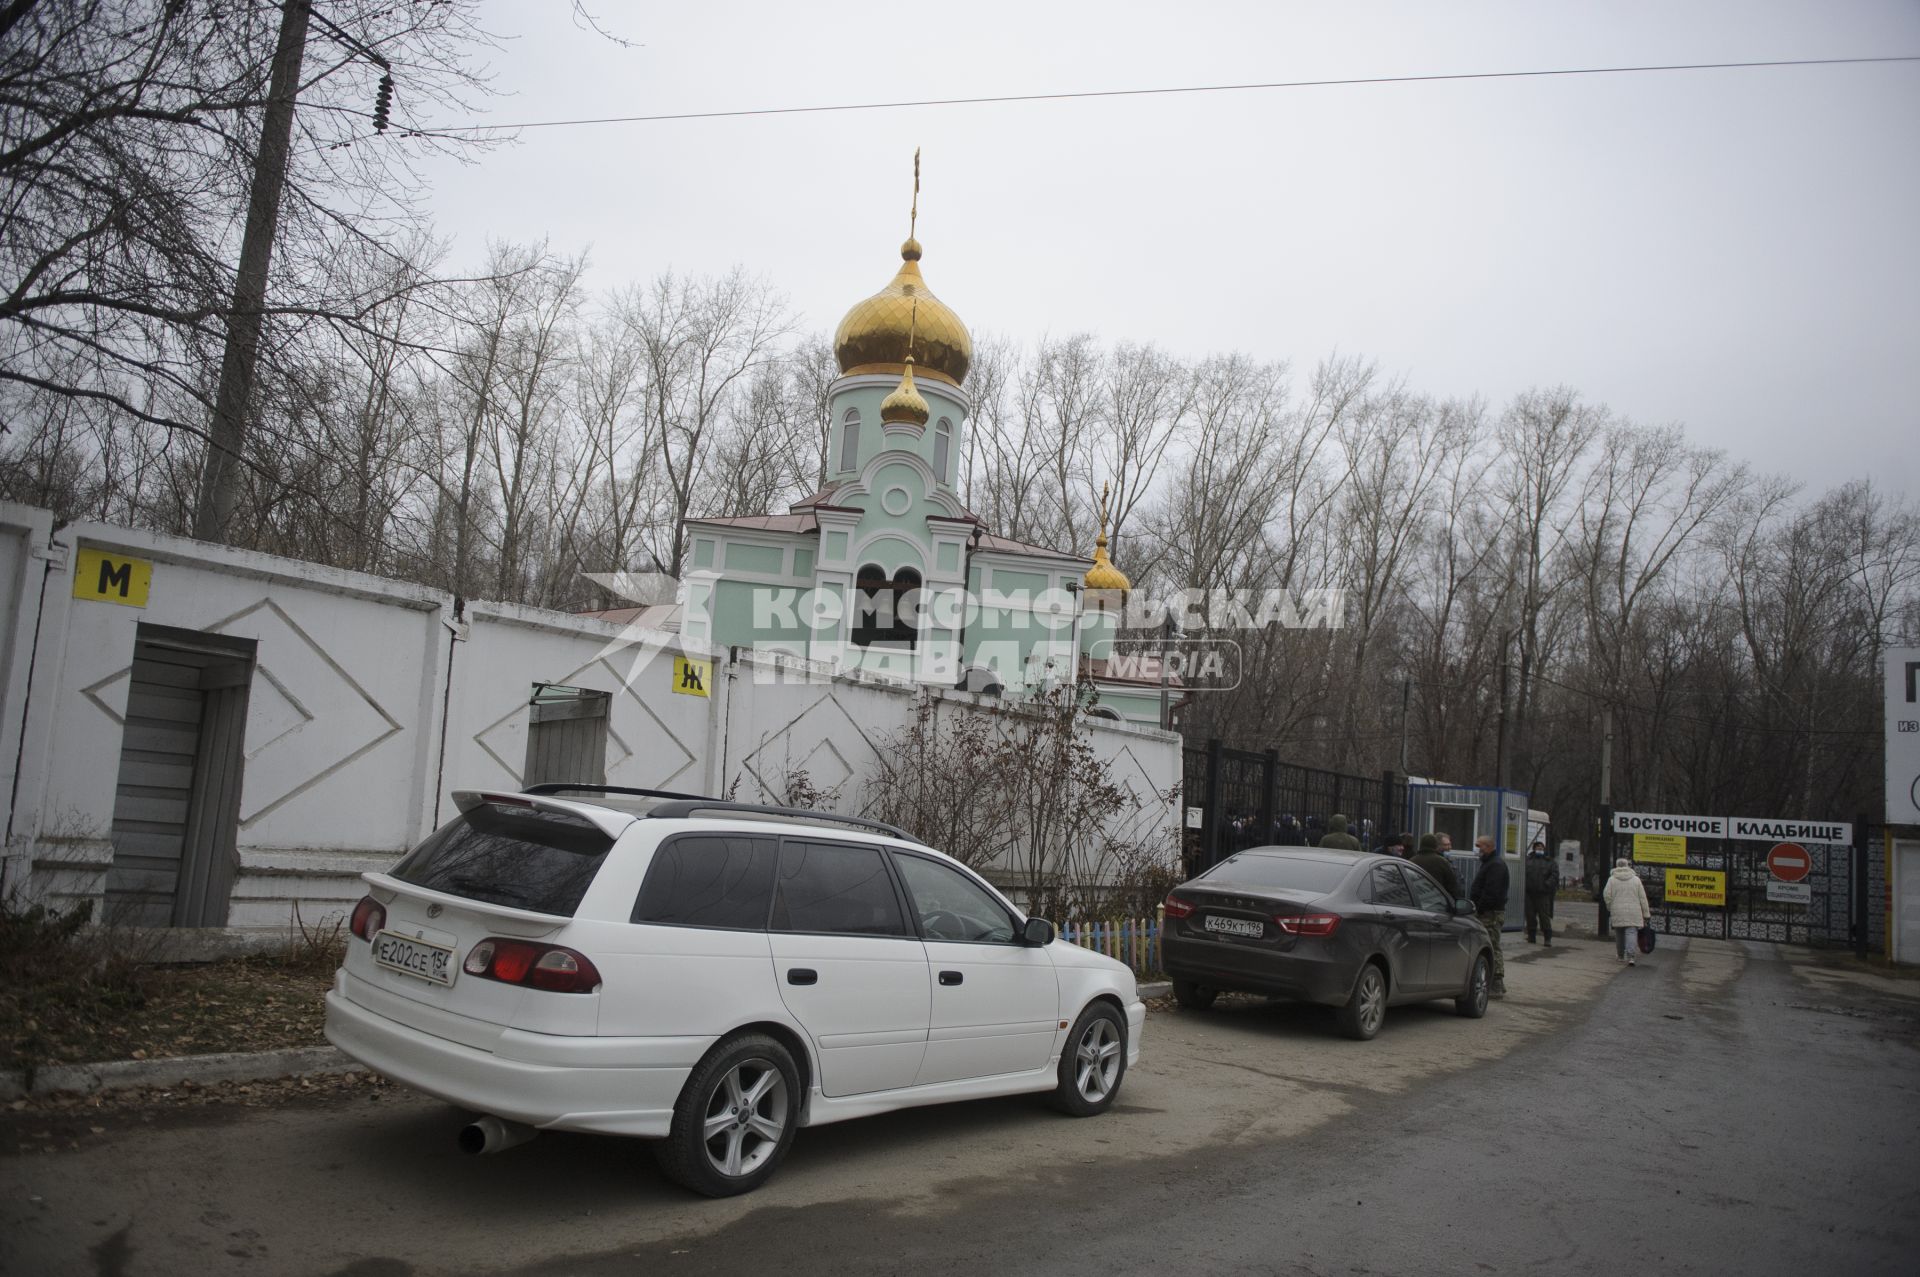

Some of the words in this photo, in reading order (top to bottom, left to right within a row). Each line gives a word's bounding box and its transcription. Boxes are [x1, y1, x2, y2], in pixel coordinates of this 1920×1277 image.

[98, 559, 132, 597] М
[681, 663, 704, 690] Ж
[1618, 816, 1722, 834] ВОСТОЧНОЕ
[1736, 822, 1843, 841] КЛАДБИЩЕ
